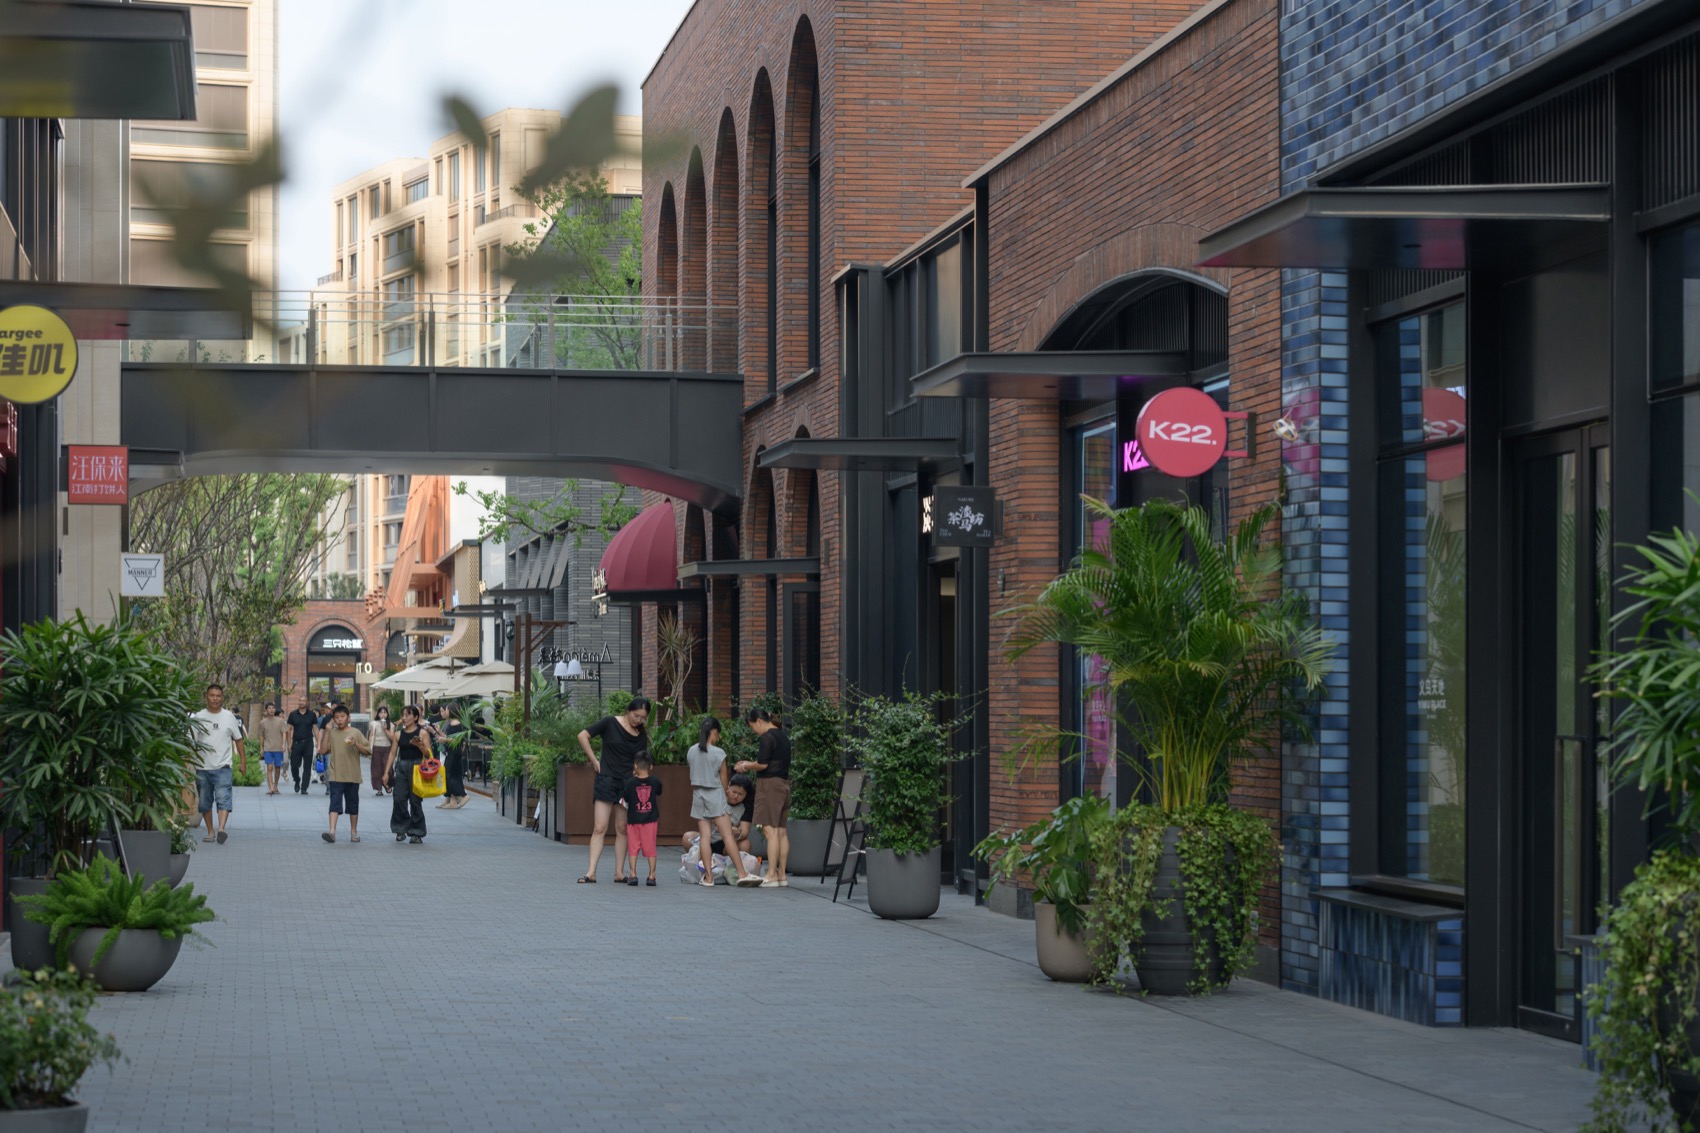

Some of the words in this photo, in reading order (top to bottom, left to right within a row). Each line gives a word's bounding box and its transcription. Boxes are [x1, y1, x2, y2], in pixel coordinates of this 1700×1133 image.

[1148, 420, 1217, 445] K22.
[71, 455, 125, 482] 汪保来
[71, 483, 126, 495] 江南打饼人
[128, 568, 153, 576] MANNER
[636, 801, 652, 811] 123
